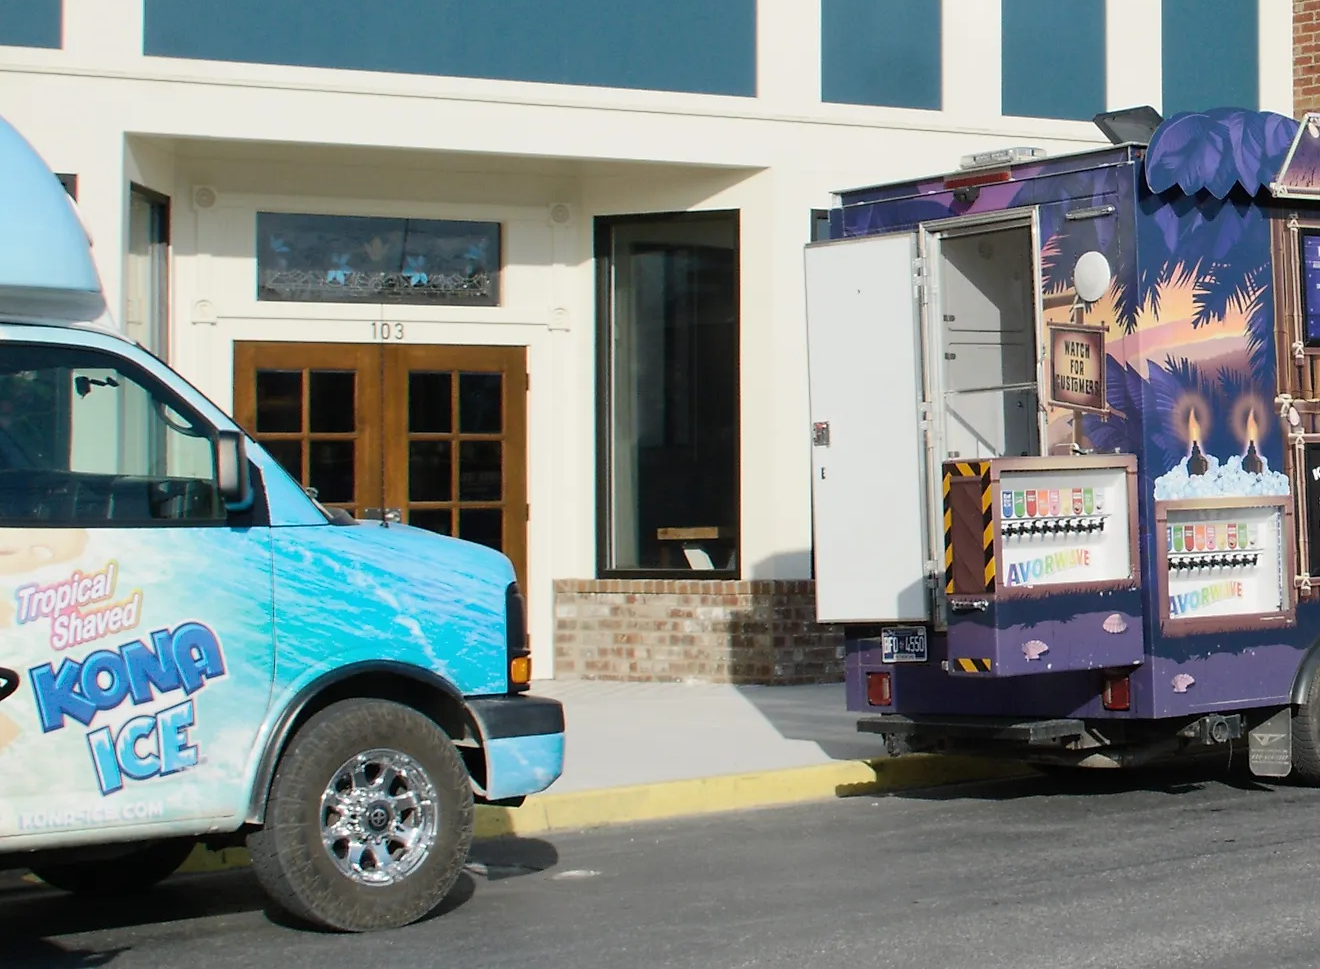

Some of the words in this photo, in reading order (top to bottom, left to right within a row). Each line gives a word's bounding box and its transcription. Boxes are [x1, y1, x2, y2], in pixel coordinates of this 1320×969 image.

[371, 322, 404, 340] 103
[1064, 340, 1090, 358] WATCH
[1056, 374, 1099, 397] CUSTOMERS
[1070, 359, 1085, 376] FOR
[17, 560, 117, 623] Tropical
[51, 589, 142, 650] Shaved
[28, 621, 227, 734] KONA
[86, 699, 199, 796] ICE
